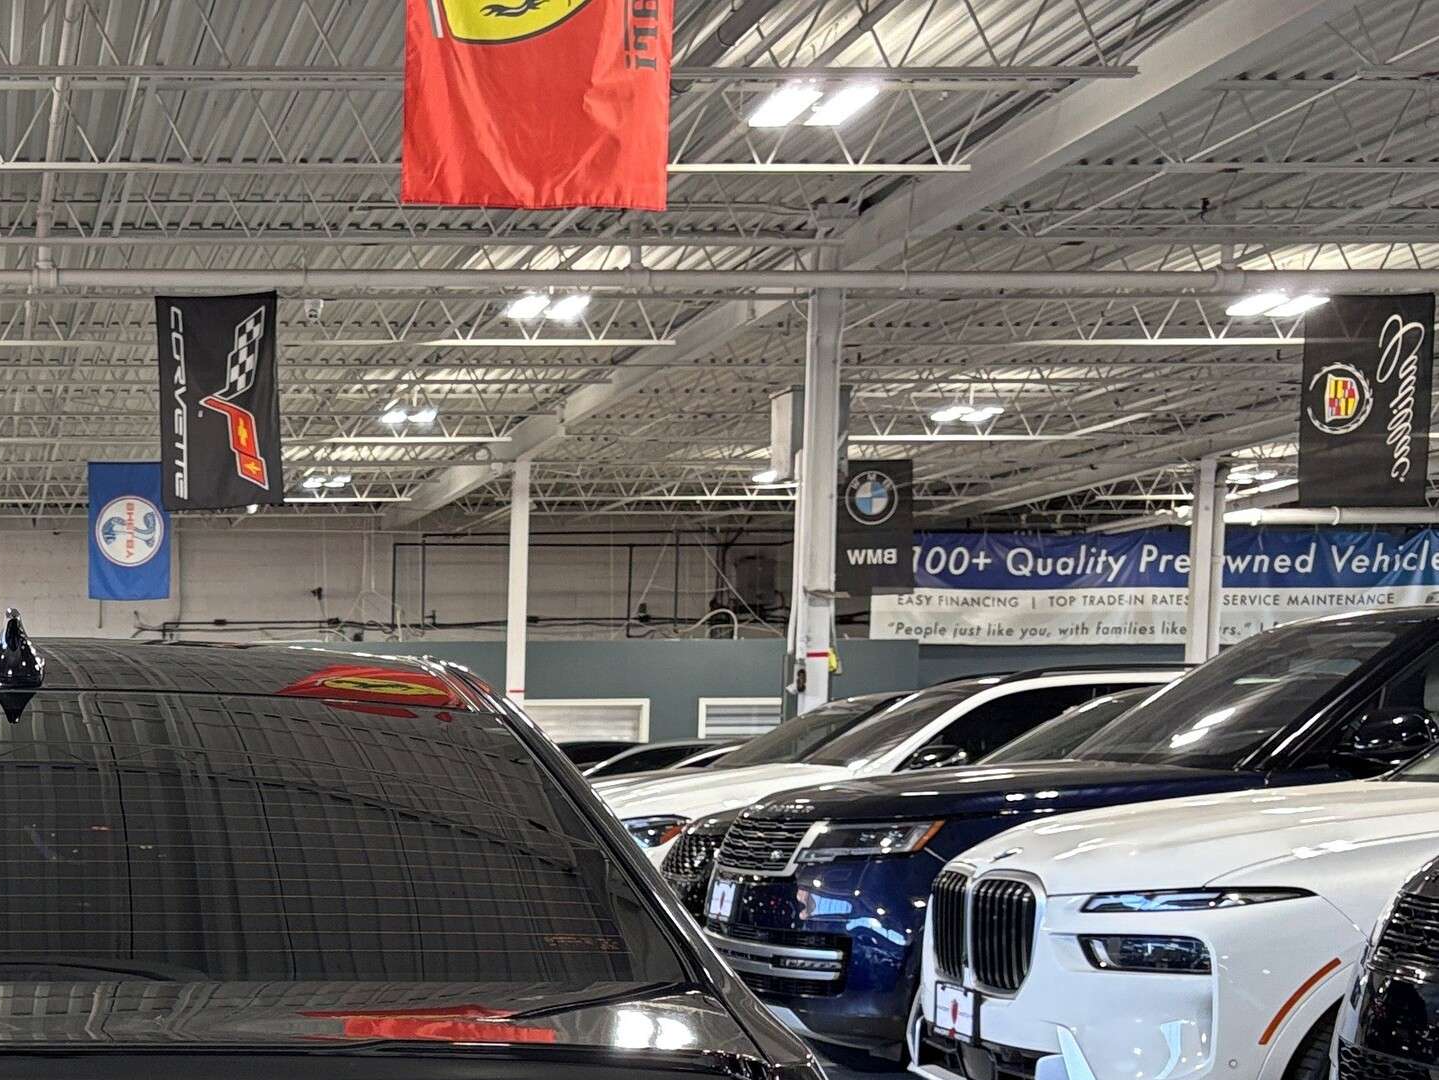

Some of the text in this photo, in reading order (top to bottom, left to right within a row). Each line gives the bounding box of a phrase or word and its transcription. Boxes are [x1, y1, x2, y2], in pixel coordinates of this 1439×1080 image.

[170, 306, 189, 500] CORVETTE
[912, 546, 992, 575] 100+
[1006, 545, 1127, 582] Quality
[1139, 542, 1316, 574] Prewned
[897, 595, 933, 606] EASY
[938, 595, 1019, 608] FINANCING
[1048, 596, 1076, 607] TOP
[1083, 594, 1145, 606] TRADE-IN
[1223, 594, 1281, 606] SERVICE
[1287, 593, 1395, 606] MAINTENANCE
[953, 623, 981, 638] just
[987, 622, 1014, 637] like
[1059, 621, 1089, 636] with
[1096, 620, 1155, 636] families
[1161, 620, 1188, 635] like
